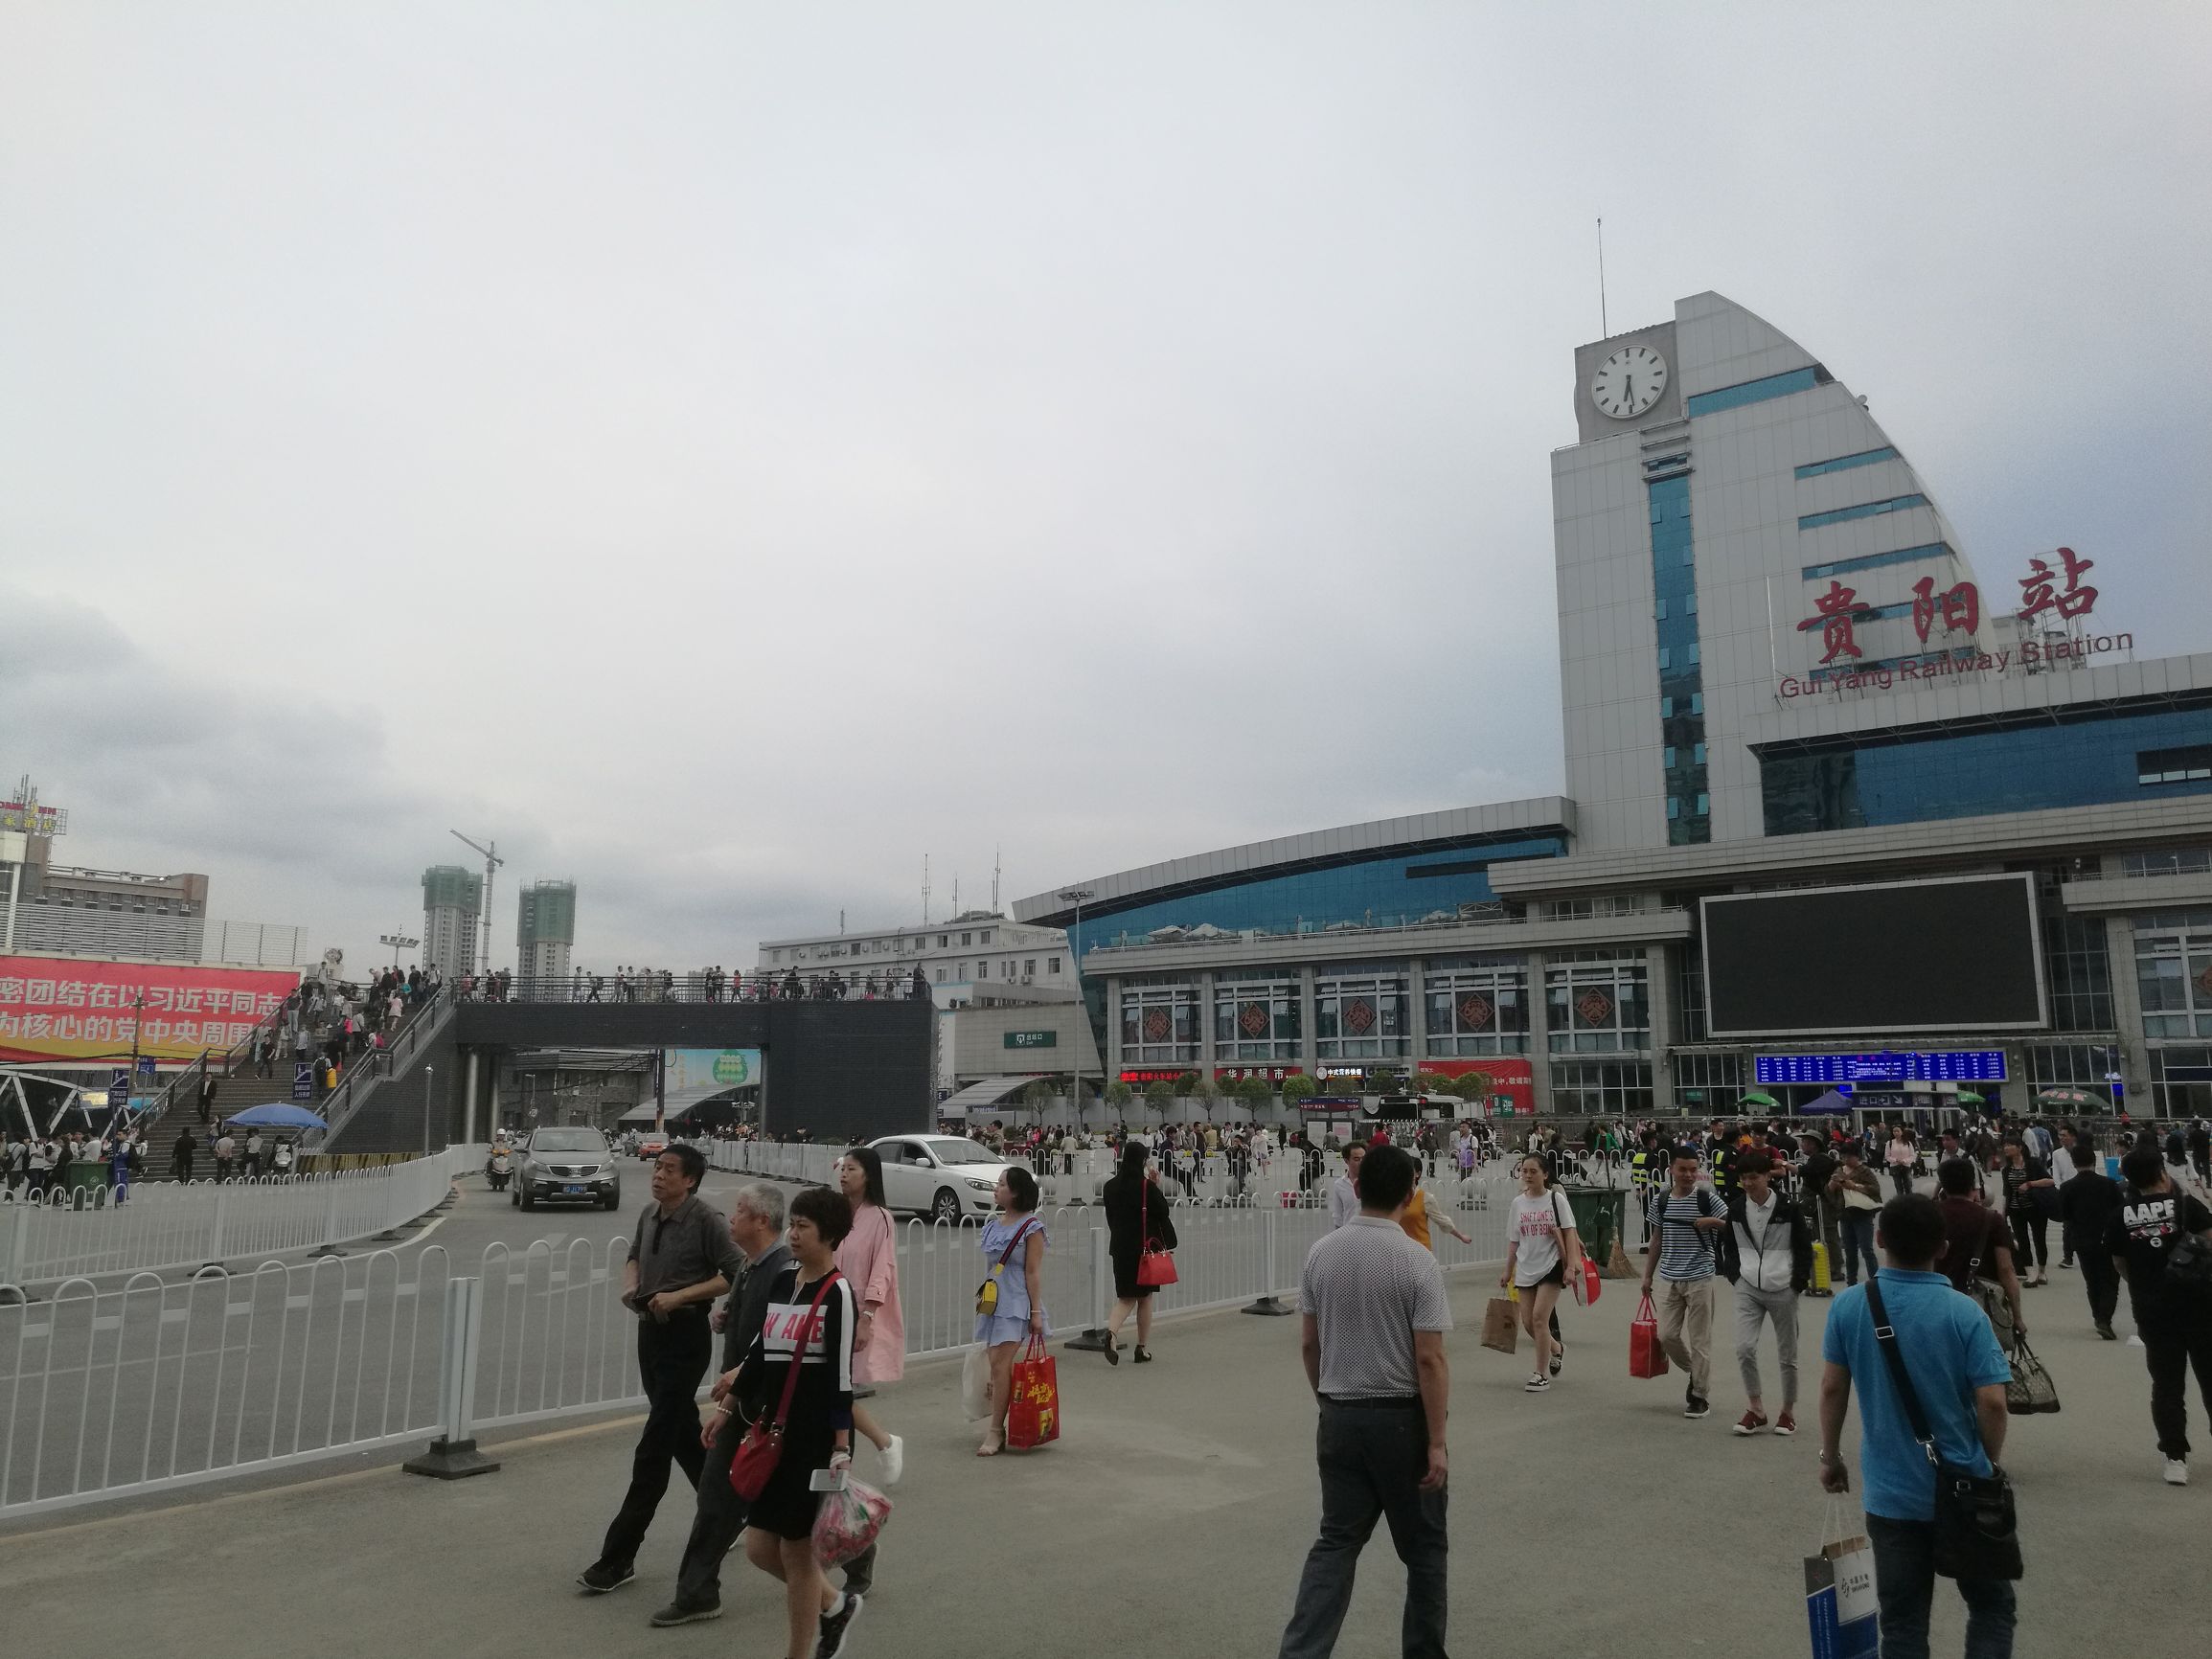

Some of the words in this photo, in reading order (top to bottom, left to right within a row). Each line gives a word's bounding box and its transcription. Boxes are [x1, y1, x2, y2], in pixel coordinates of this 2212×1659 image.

[1796, 547, 2100, 665] 贵阳站
[1779, 674, 1823, 698] Gui
[1828, 668, 1893, 691] Yang
[1899, 648, 2011, 681] Railway
[2020, 632, 2134, 664] Station
[1227, 1068, 1285, 1079] 华润超市
[2123, 1199, 2176, 1224] AAPE
[1530, 1224, 1539, 1236] OF
